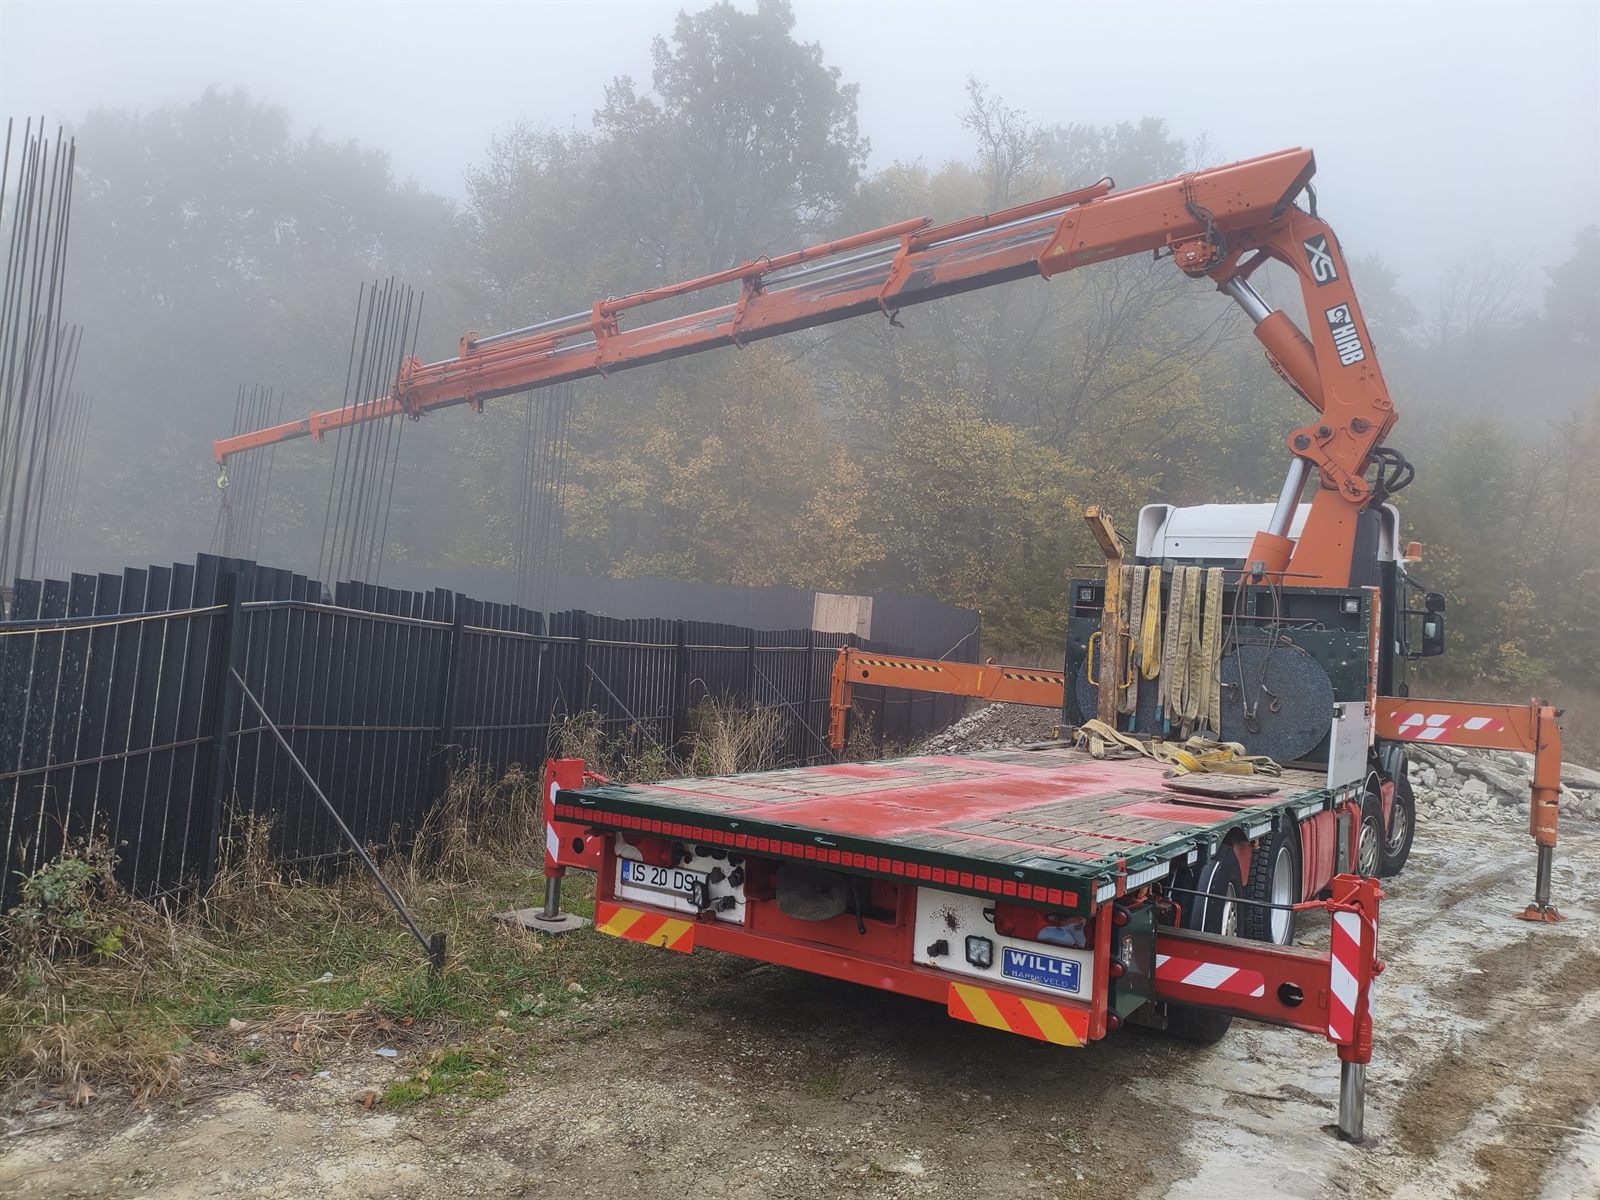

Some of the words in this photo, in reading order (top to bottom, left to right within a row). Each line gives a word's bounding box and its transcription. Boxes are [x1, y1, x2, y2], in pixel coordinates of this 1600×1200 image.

[1303, 239, 1337, 281] XS
[1331, 323, 1365, 366] HIAB
[632, 863, 646, 882] IS
[651, 867, 668, 886] 20
[673, 871, 699, 893] DS
[1010, 952, 1072, 977] WILLE
[1011, 970, 1068, 988] BARNEVELD
